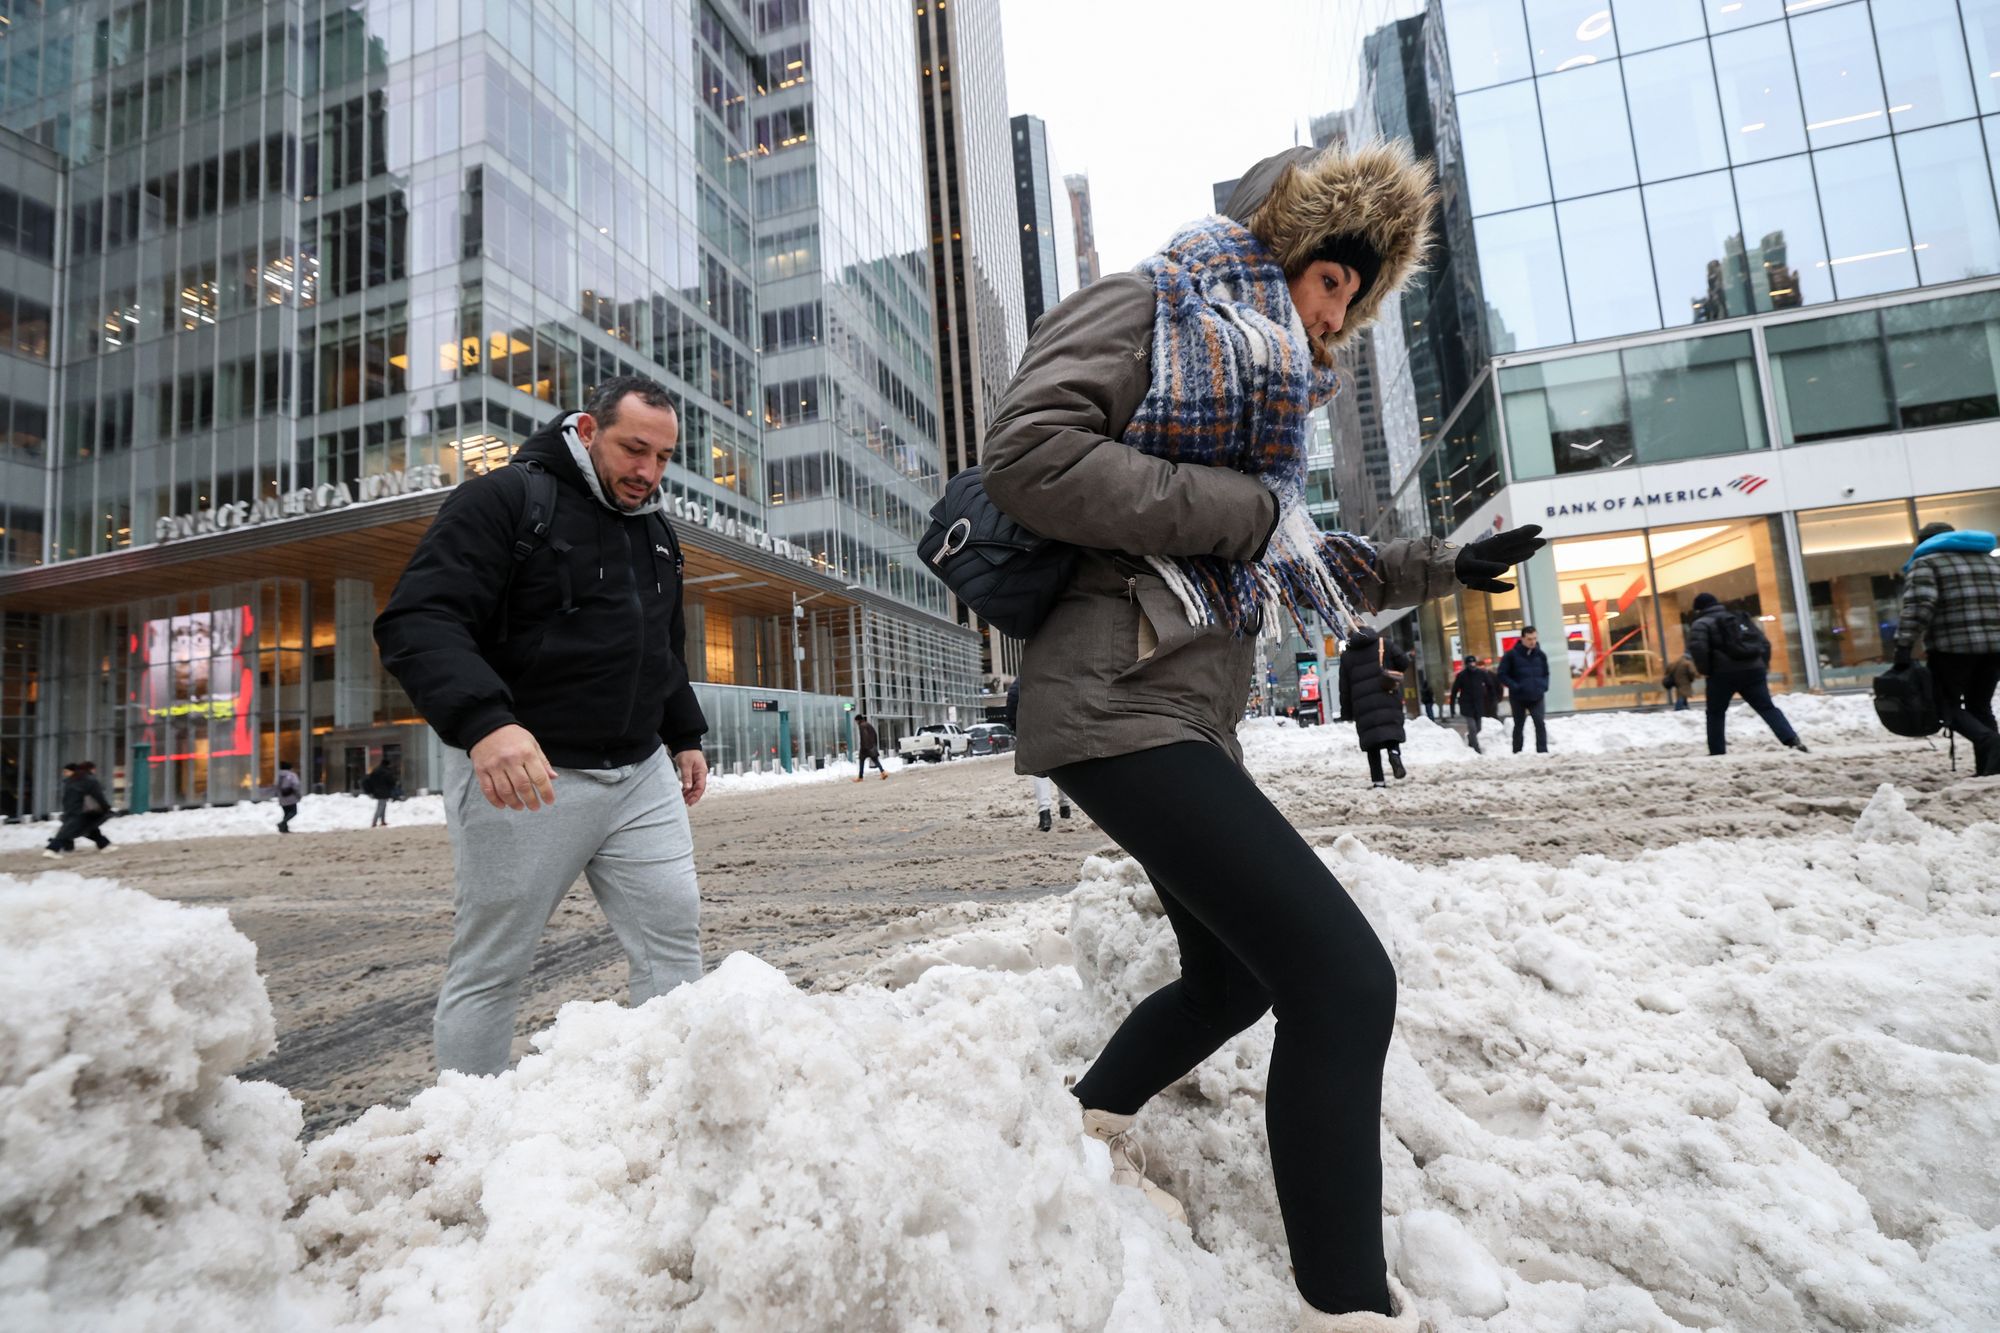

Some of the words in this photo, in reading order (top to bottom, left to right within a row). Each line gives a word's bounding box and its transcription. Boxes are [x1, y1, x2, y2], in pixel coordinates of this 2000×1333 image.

[1547, 500, 1597, 517] BANK
[1604, 497, 1626, 511] OF
[1633, 486, 1723, 507] AMERICA
